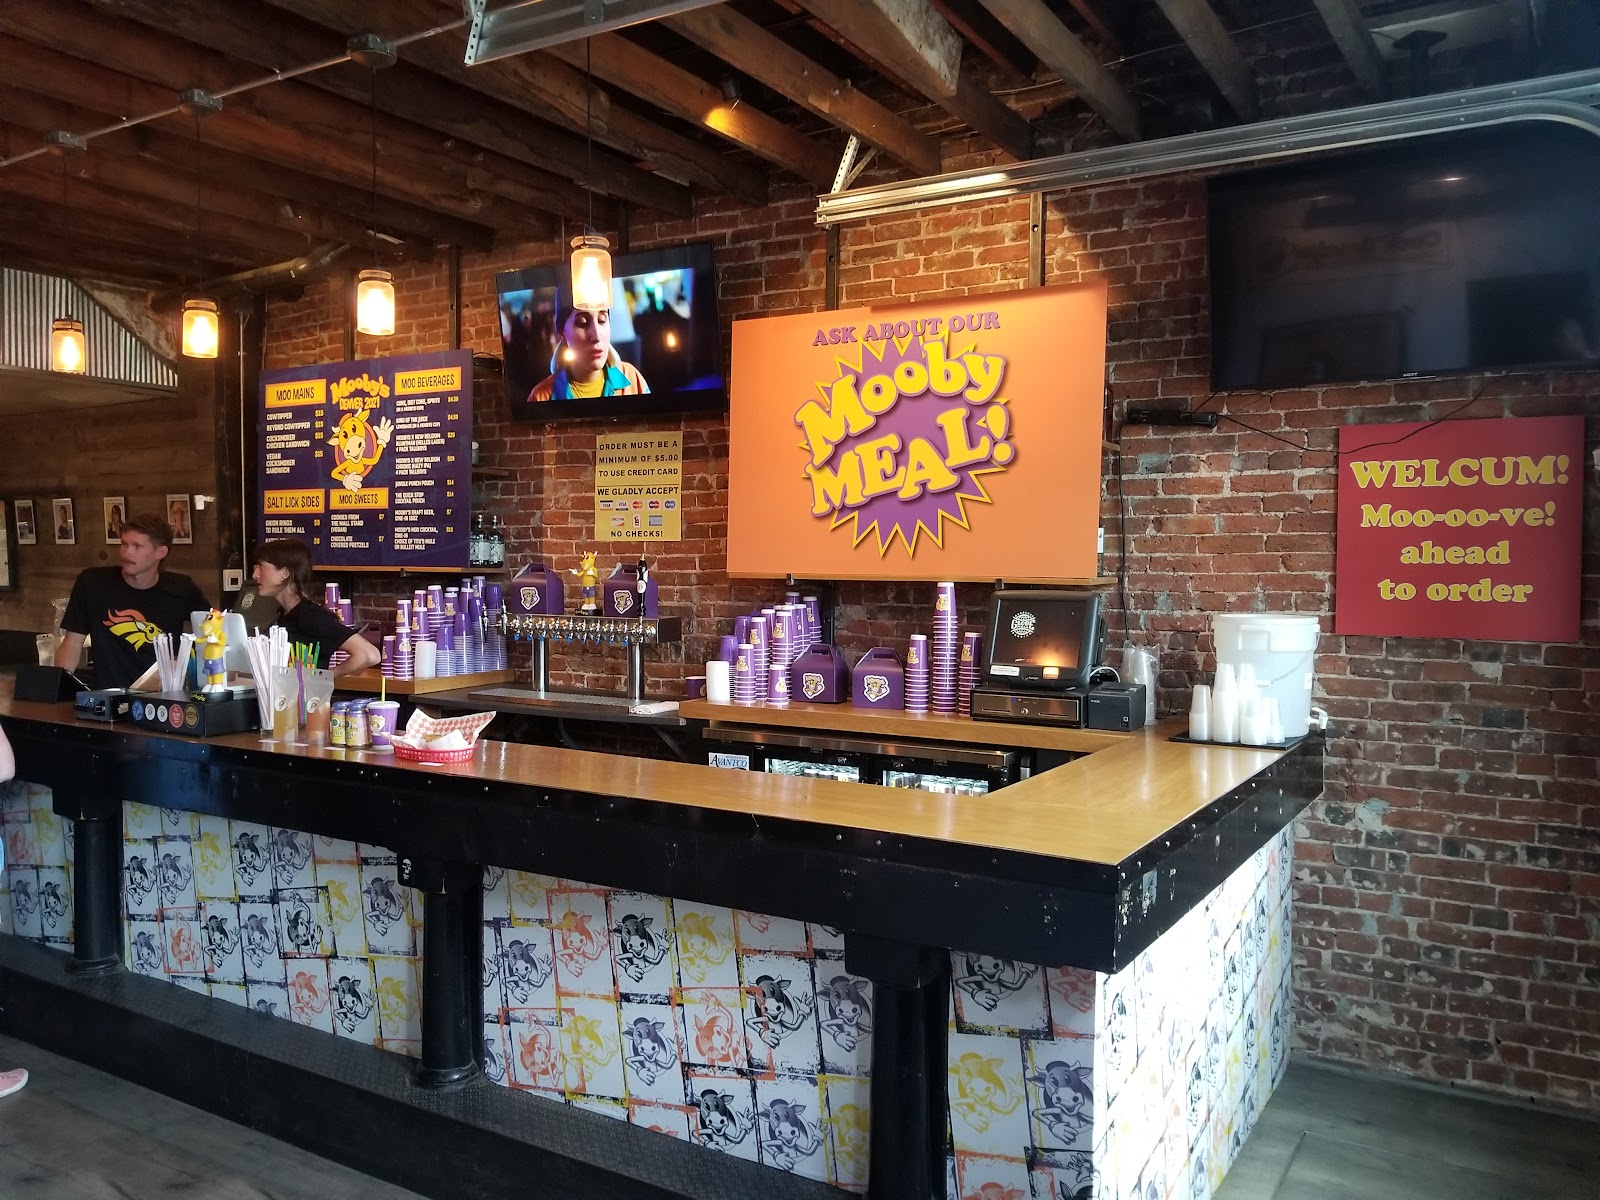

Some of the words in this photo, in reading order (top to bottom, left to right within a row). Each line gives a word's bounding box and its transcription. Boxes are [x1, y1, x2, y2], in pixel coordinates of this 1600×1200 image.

[812, 326, 858, 346] ASK
[864, 318, 943, 341] ABOUT
[947, 311, 1000, 333] OUR
[330, 373, 390, 405] Mooby's
[401, 378, 416, 390] MOO
[418, 374, 455, 388] BEVERAGES
[276, 389, 292, 402] MOO
[293, 387, 315, 400] MAINS
[340, 397, 364, 410] DENVER
[364, 396, 380, 410] 2021
[795, 340, 1006, 469] Mooby
[266, 412, 292, 420] COWTIPPER
[284, 422, 310, 430] COWTIPPER
[286, 440, 310, 448] SANDWICH
[599, 443, 627, 451] ORDER
[315, 450, 324, 458] $15
[599, 456, 637, 464] MINIMUM
[655, 454, 678, 462] $5.00
[804, 403, 1015, 517] MEAL!
[1348, 454, 1570, 488] WELCUM!
[339, 494, 353, 504] MOO
[354, 493, 379, 504] SWEETS
[597, 488, 609, 496] WE
[612, 487, 644, 496] GLADLY
[646, 487, 679, 495] ACCEPT
[267, 497, 283, 509] SALT
[285, 496, 299, 508] LICK
[301, 495, 320, 508] SIDES
[1360, 501, 1556, 528] Moo-oo-ve!
[1400, 540, 1510, 566] ahead
[1378, 579, 1416, 602] to
[1426, 577, 1534, 604] order
[710, 754, 748, 768] AVANTCO
